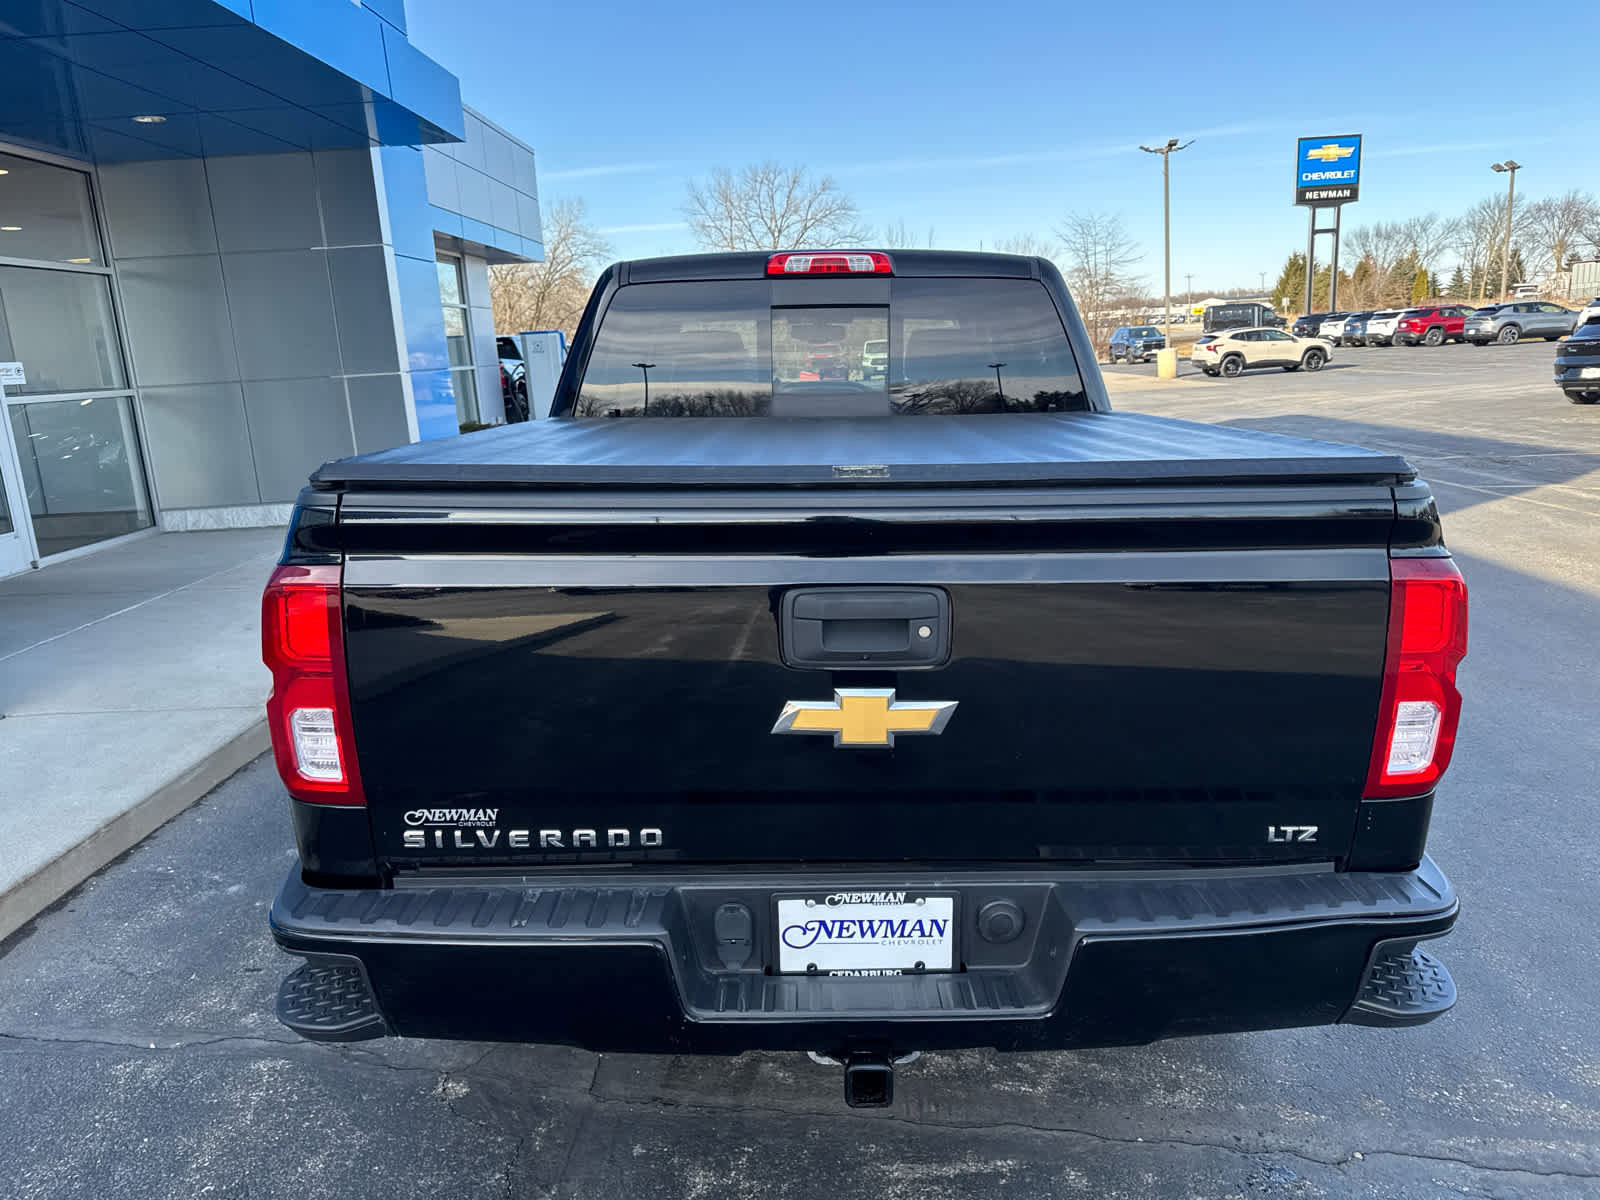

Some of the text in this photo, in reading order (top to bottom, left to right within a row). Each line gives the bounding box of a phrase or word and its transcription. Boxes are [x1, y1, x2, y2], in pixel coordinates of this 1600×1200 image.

[1302, 170, 1356, 181] CHEVROLET
[1305, 189, 1351, 200] NEWMAN
[404, 808, 499, 826] NEWMAN
[403, 828, 663, 849] SILVERADO
[1268, 826, 1318, 842] LTZ
[825, 892, 906, 908] NEWMAN
[782, 919, 949, 949] NEWMAN
